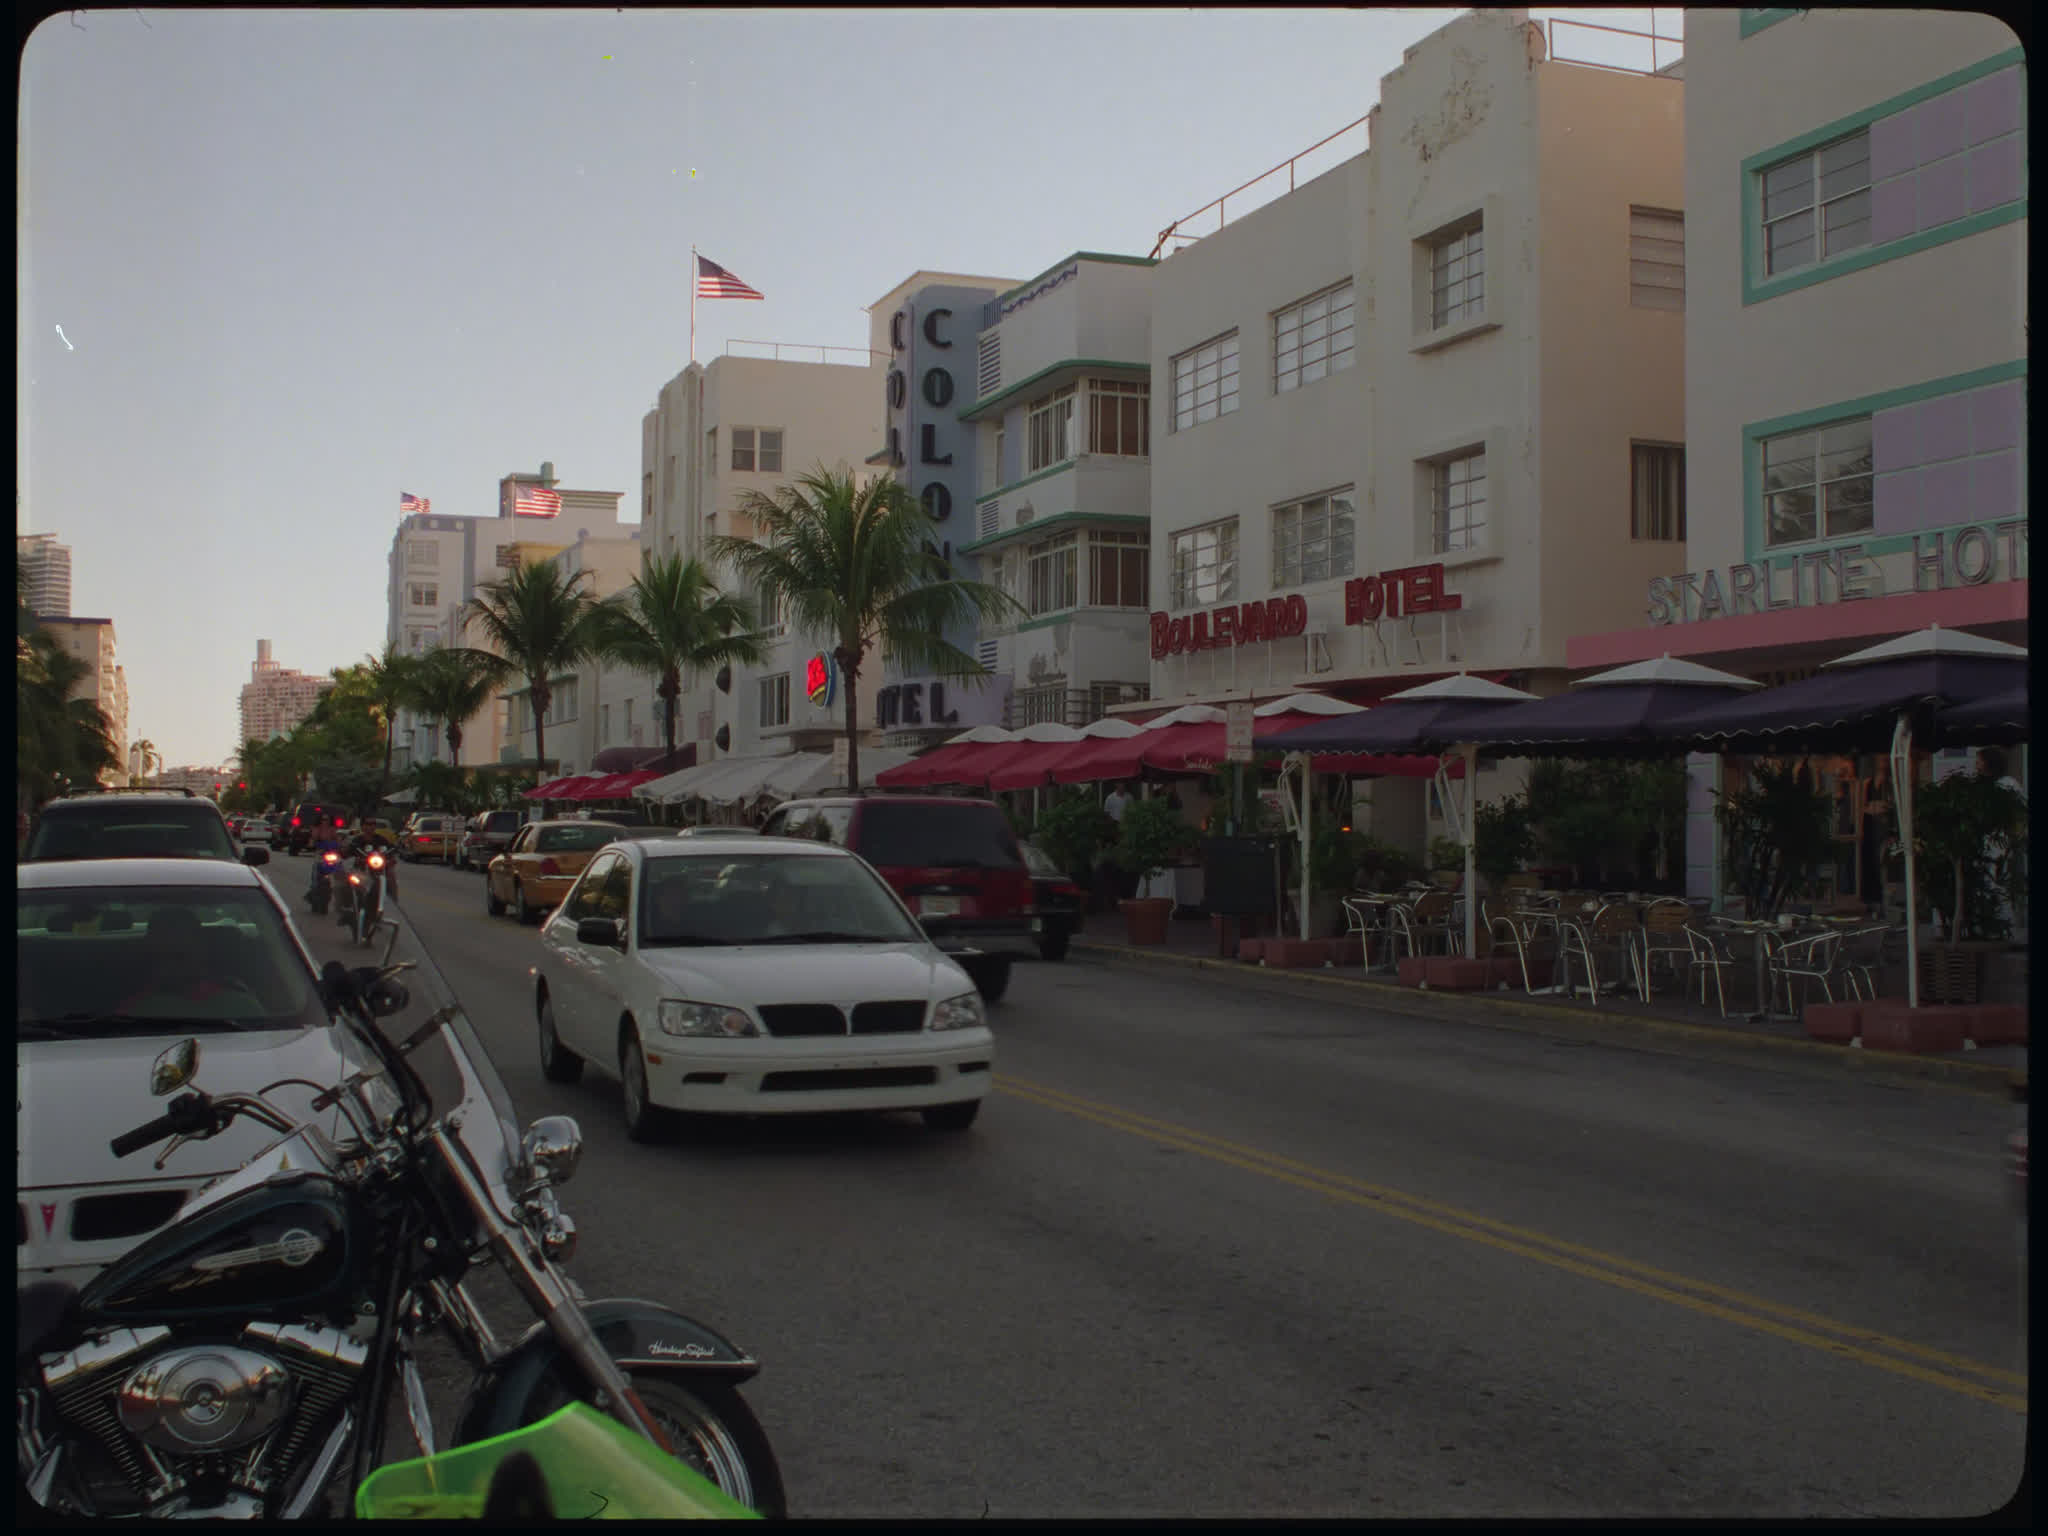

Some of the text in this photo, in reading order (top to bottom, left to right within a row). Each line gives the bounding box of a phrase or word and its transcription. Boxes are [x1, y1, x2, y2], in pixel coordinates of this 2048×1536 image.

[1150, 563, 1462, 660] BOULEVARD HOTEL
[1647, 545, 1868, 626] STARLITE
